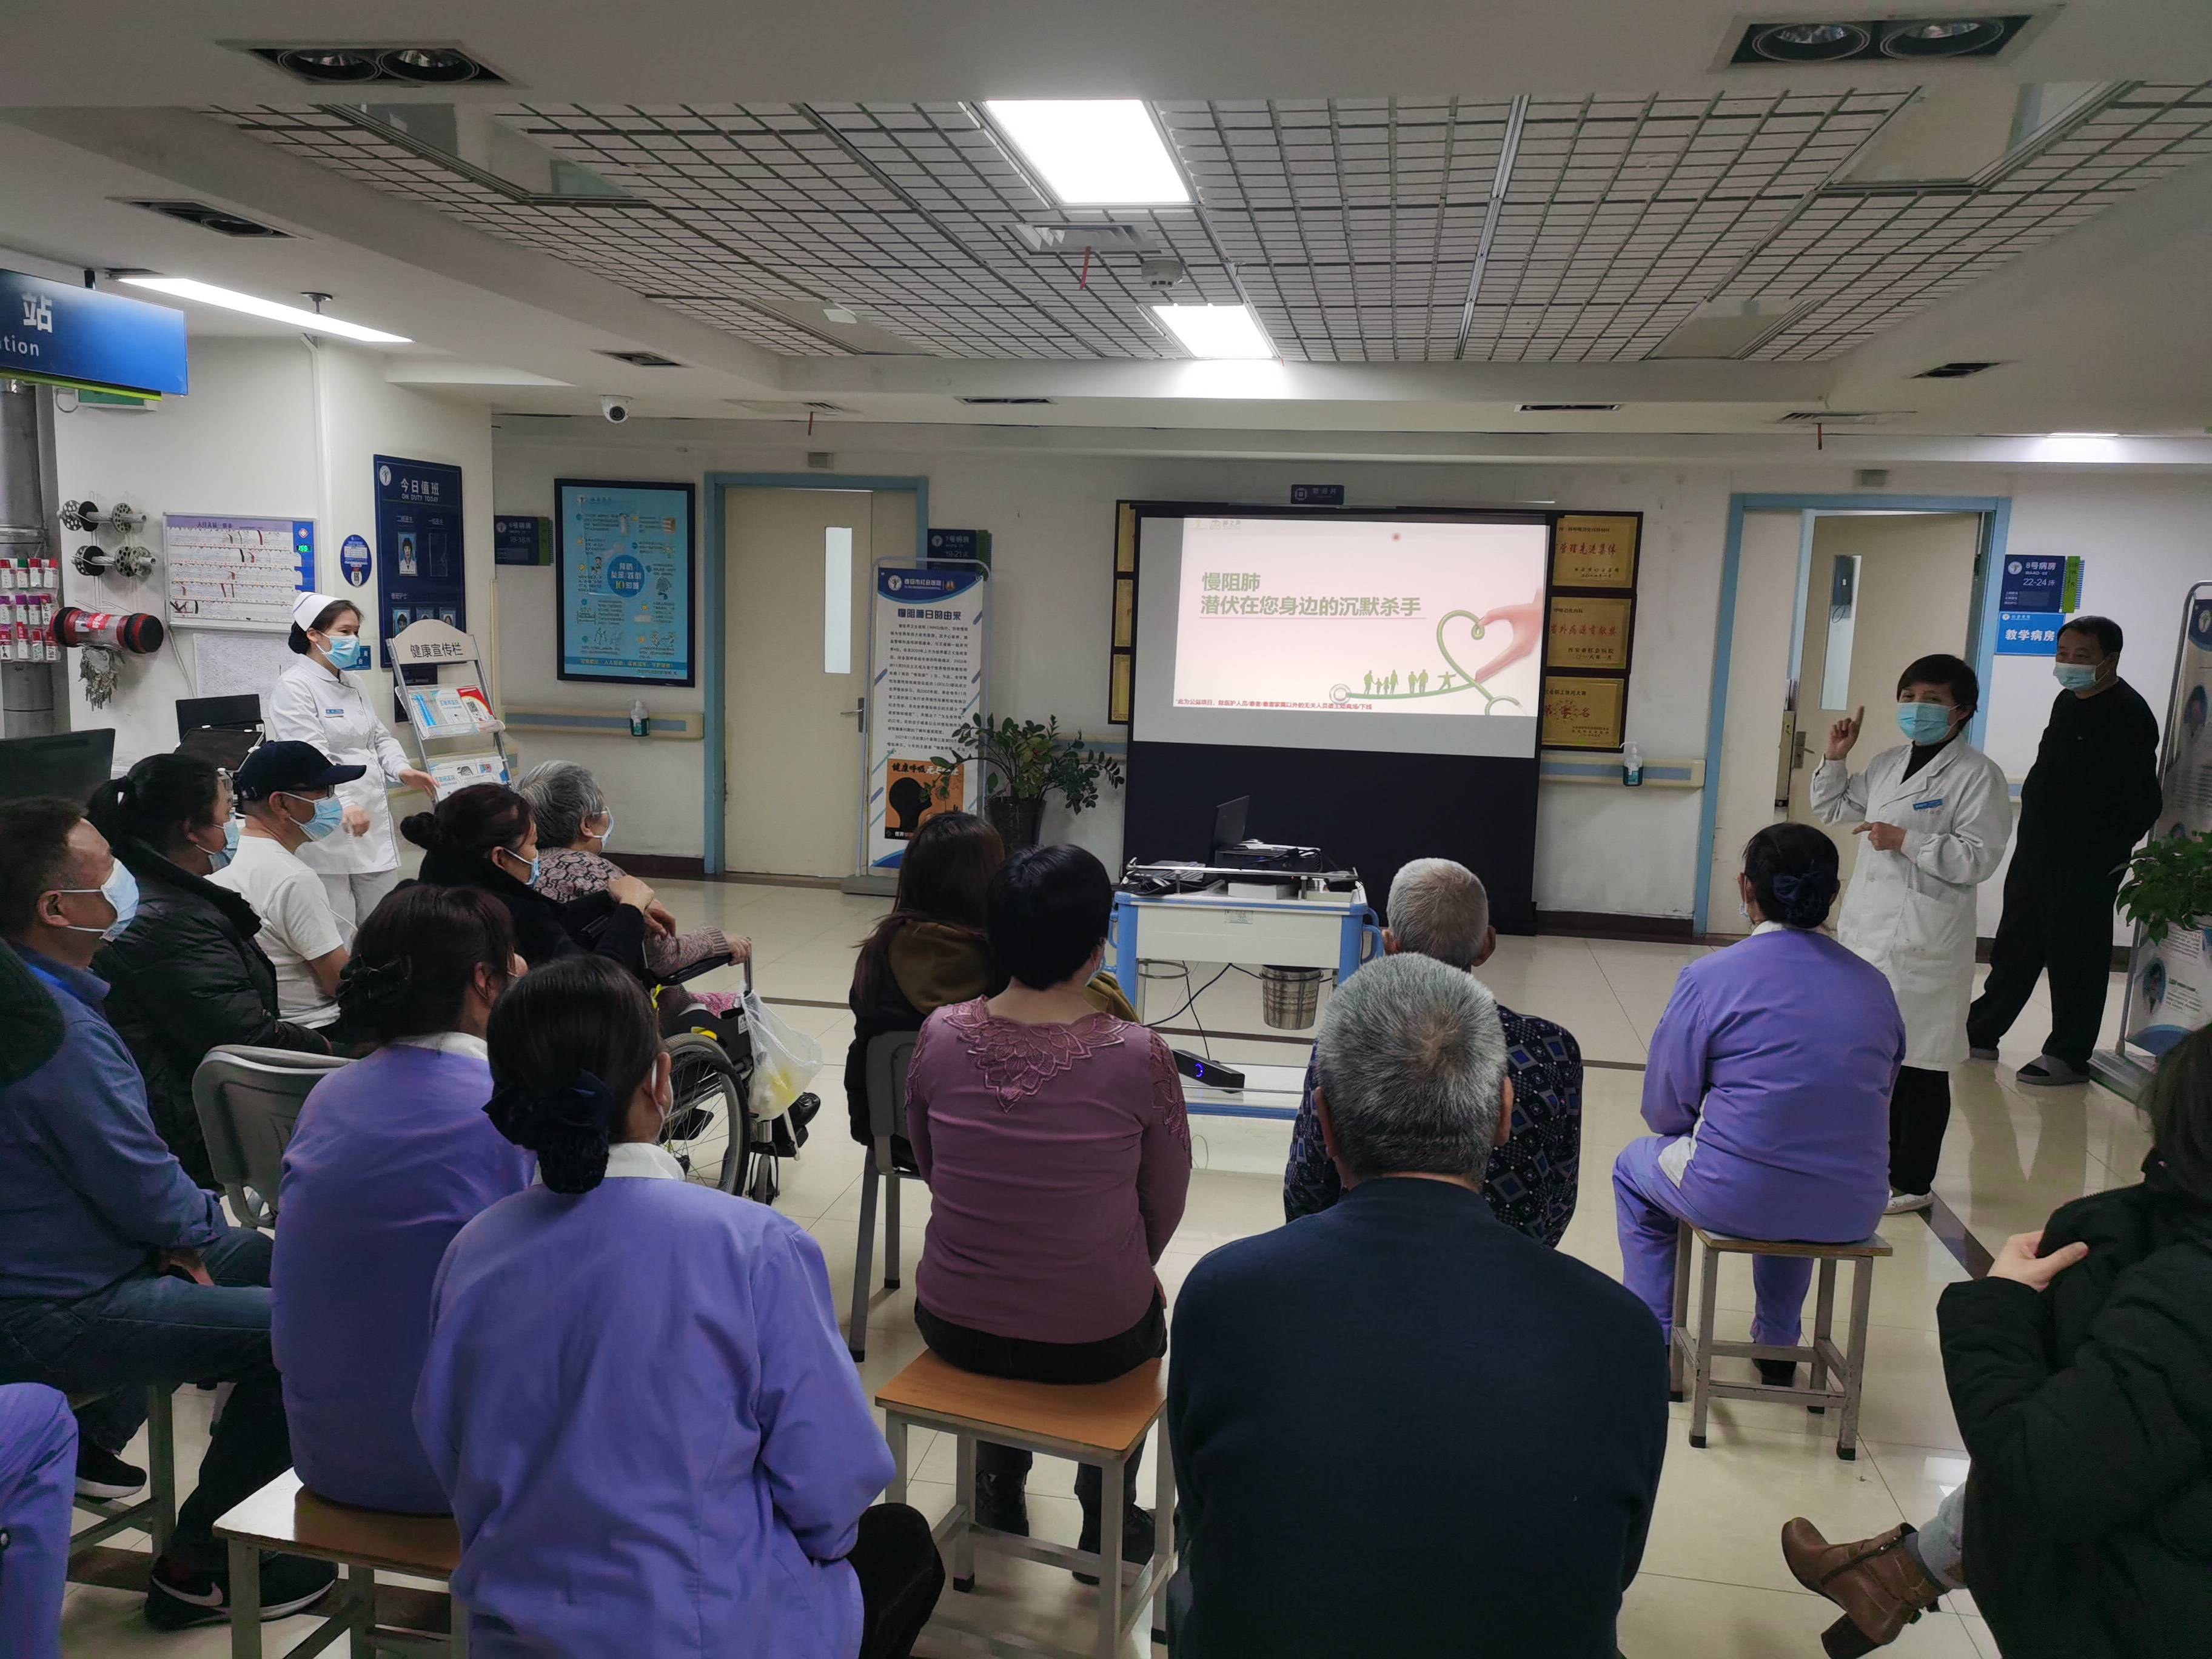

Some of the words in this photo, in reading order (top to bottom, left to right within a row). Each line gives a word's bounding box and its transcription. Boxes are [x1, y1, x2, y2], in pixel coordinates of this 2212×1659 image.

[22, 293, 53, 333] 站
[0, 334, 39, 357] tion
[400, 477, 440, 496] 今日值班
[2026, 561, 2056, 571] 8号病房
[1202, 572, 1261, 592] 慢阻肺
[1200, 595, 1421, 617] 潜伏在您身边的沉默杀手
[2005, 629, 2056, 642] 教学病房
[410, 642, 464, 658] 健康宣传栏
[892, 763, 925, 773] 健康呼吸
